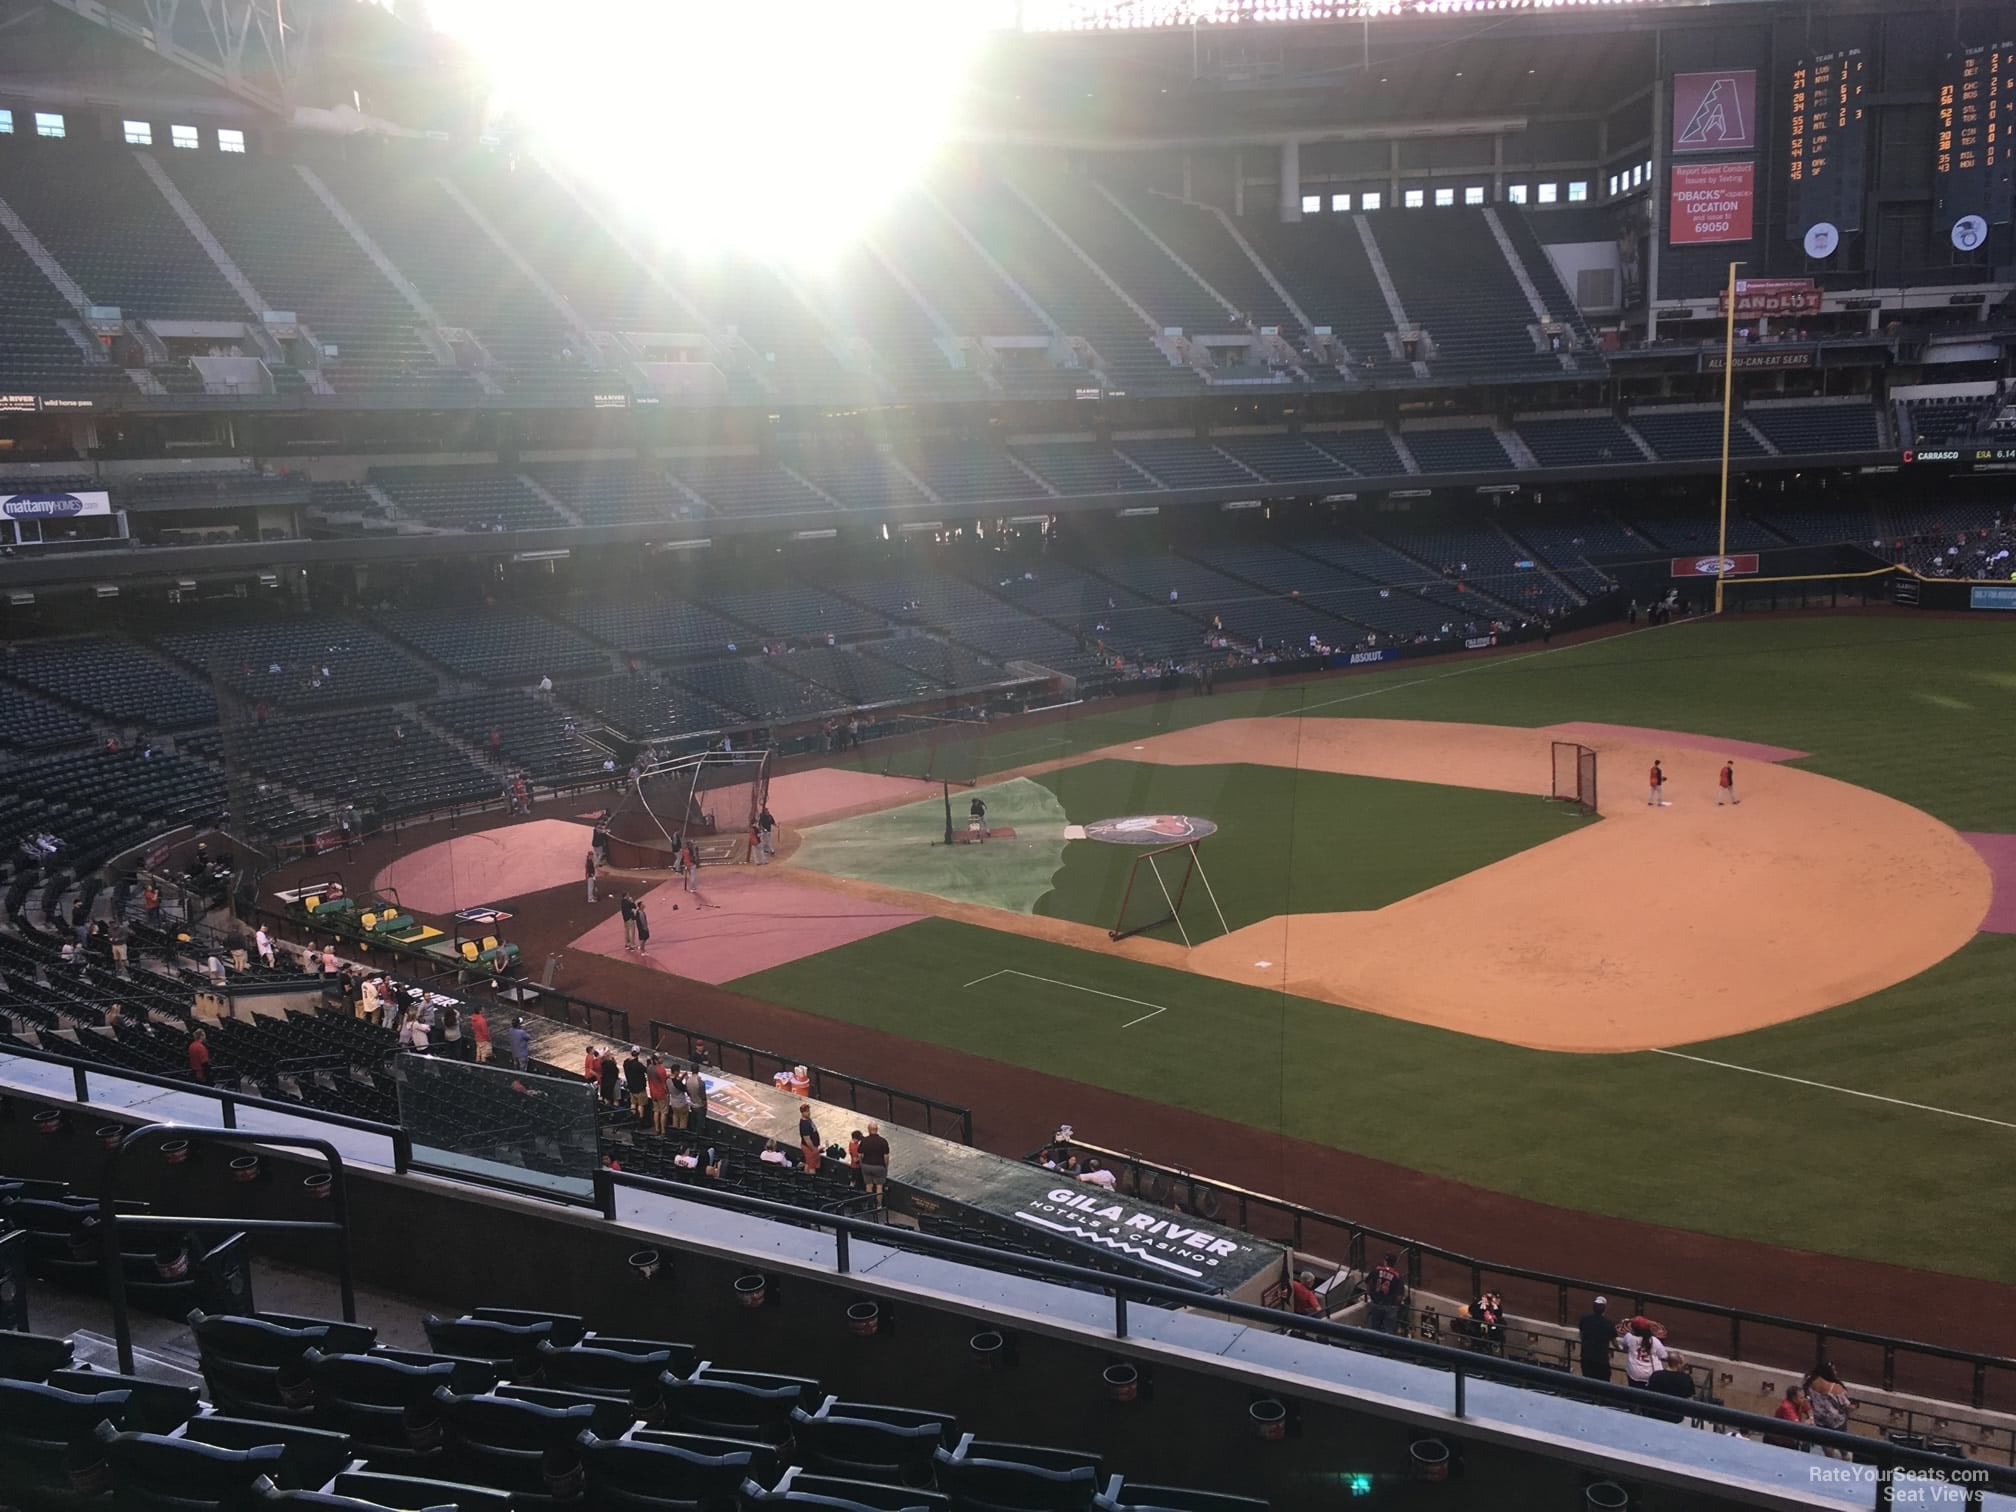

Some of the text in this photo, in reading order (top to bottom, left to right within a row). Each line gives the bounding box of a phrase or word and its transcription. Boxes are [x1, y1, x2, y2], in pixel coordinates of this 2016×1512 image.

[1991, 54, 1999, 63] 2
[1991, 64, 1999, 73] 2
[1841, 71, 1848, 80] 3
[1991, 77, 1998, 86] 2
[1990, 87, 1997, 96] 2
[1840, 95, 1847, 104] 3
[1839, 108, 1846, 117] 2
[1855, 110, 1862, 119] 3
[1701, 166, 1722, 175] Guest
[1723, 165, 1752, 173] Conduct
[1687, 201, 1738, 214] LOCATION
[1695, 222, 1730, 233] 69050
[1709, 355, 1808, 369] ALL-OU-CAN-EAT SEATS
[1918, 452, 1959, 460] CARRASCO
[1976, 451, 1992, 459] ERA
[710, 1092, 756, 1113] FIELD
[1047, 1189, 1125, 1222] GILA
[1124, 1212, 1238, 1258] RIVER
[1030, 1200, 1221, 1268] HOTELS & CASINOS
